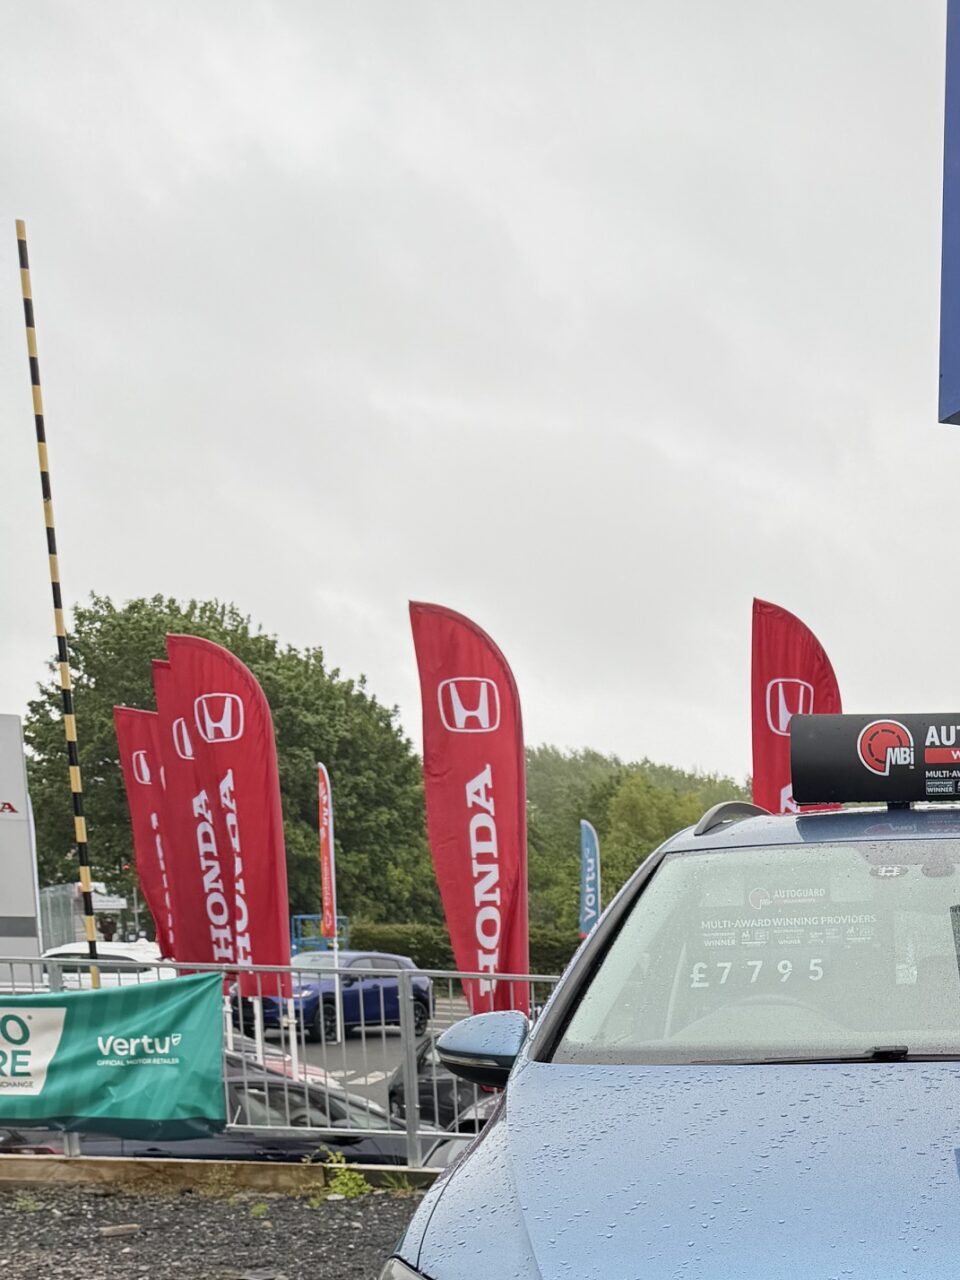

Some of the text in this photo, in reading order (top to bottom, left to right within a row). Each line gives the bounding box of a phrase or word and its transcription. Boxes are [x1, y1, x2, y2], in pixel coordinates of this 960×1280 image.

[927, 786, 954, 794] WINNER
[192, 789, 235, 963] HONDA
[466, 763, 501, 996] HONDA
[773, 887, 826, 899] AUTOGUARD
[701, 914, 877, 929] MULTI-AWARD WINNING PROVIDERS
[97, 1034, 170, 1056] Vertu
